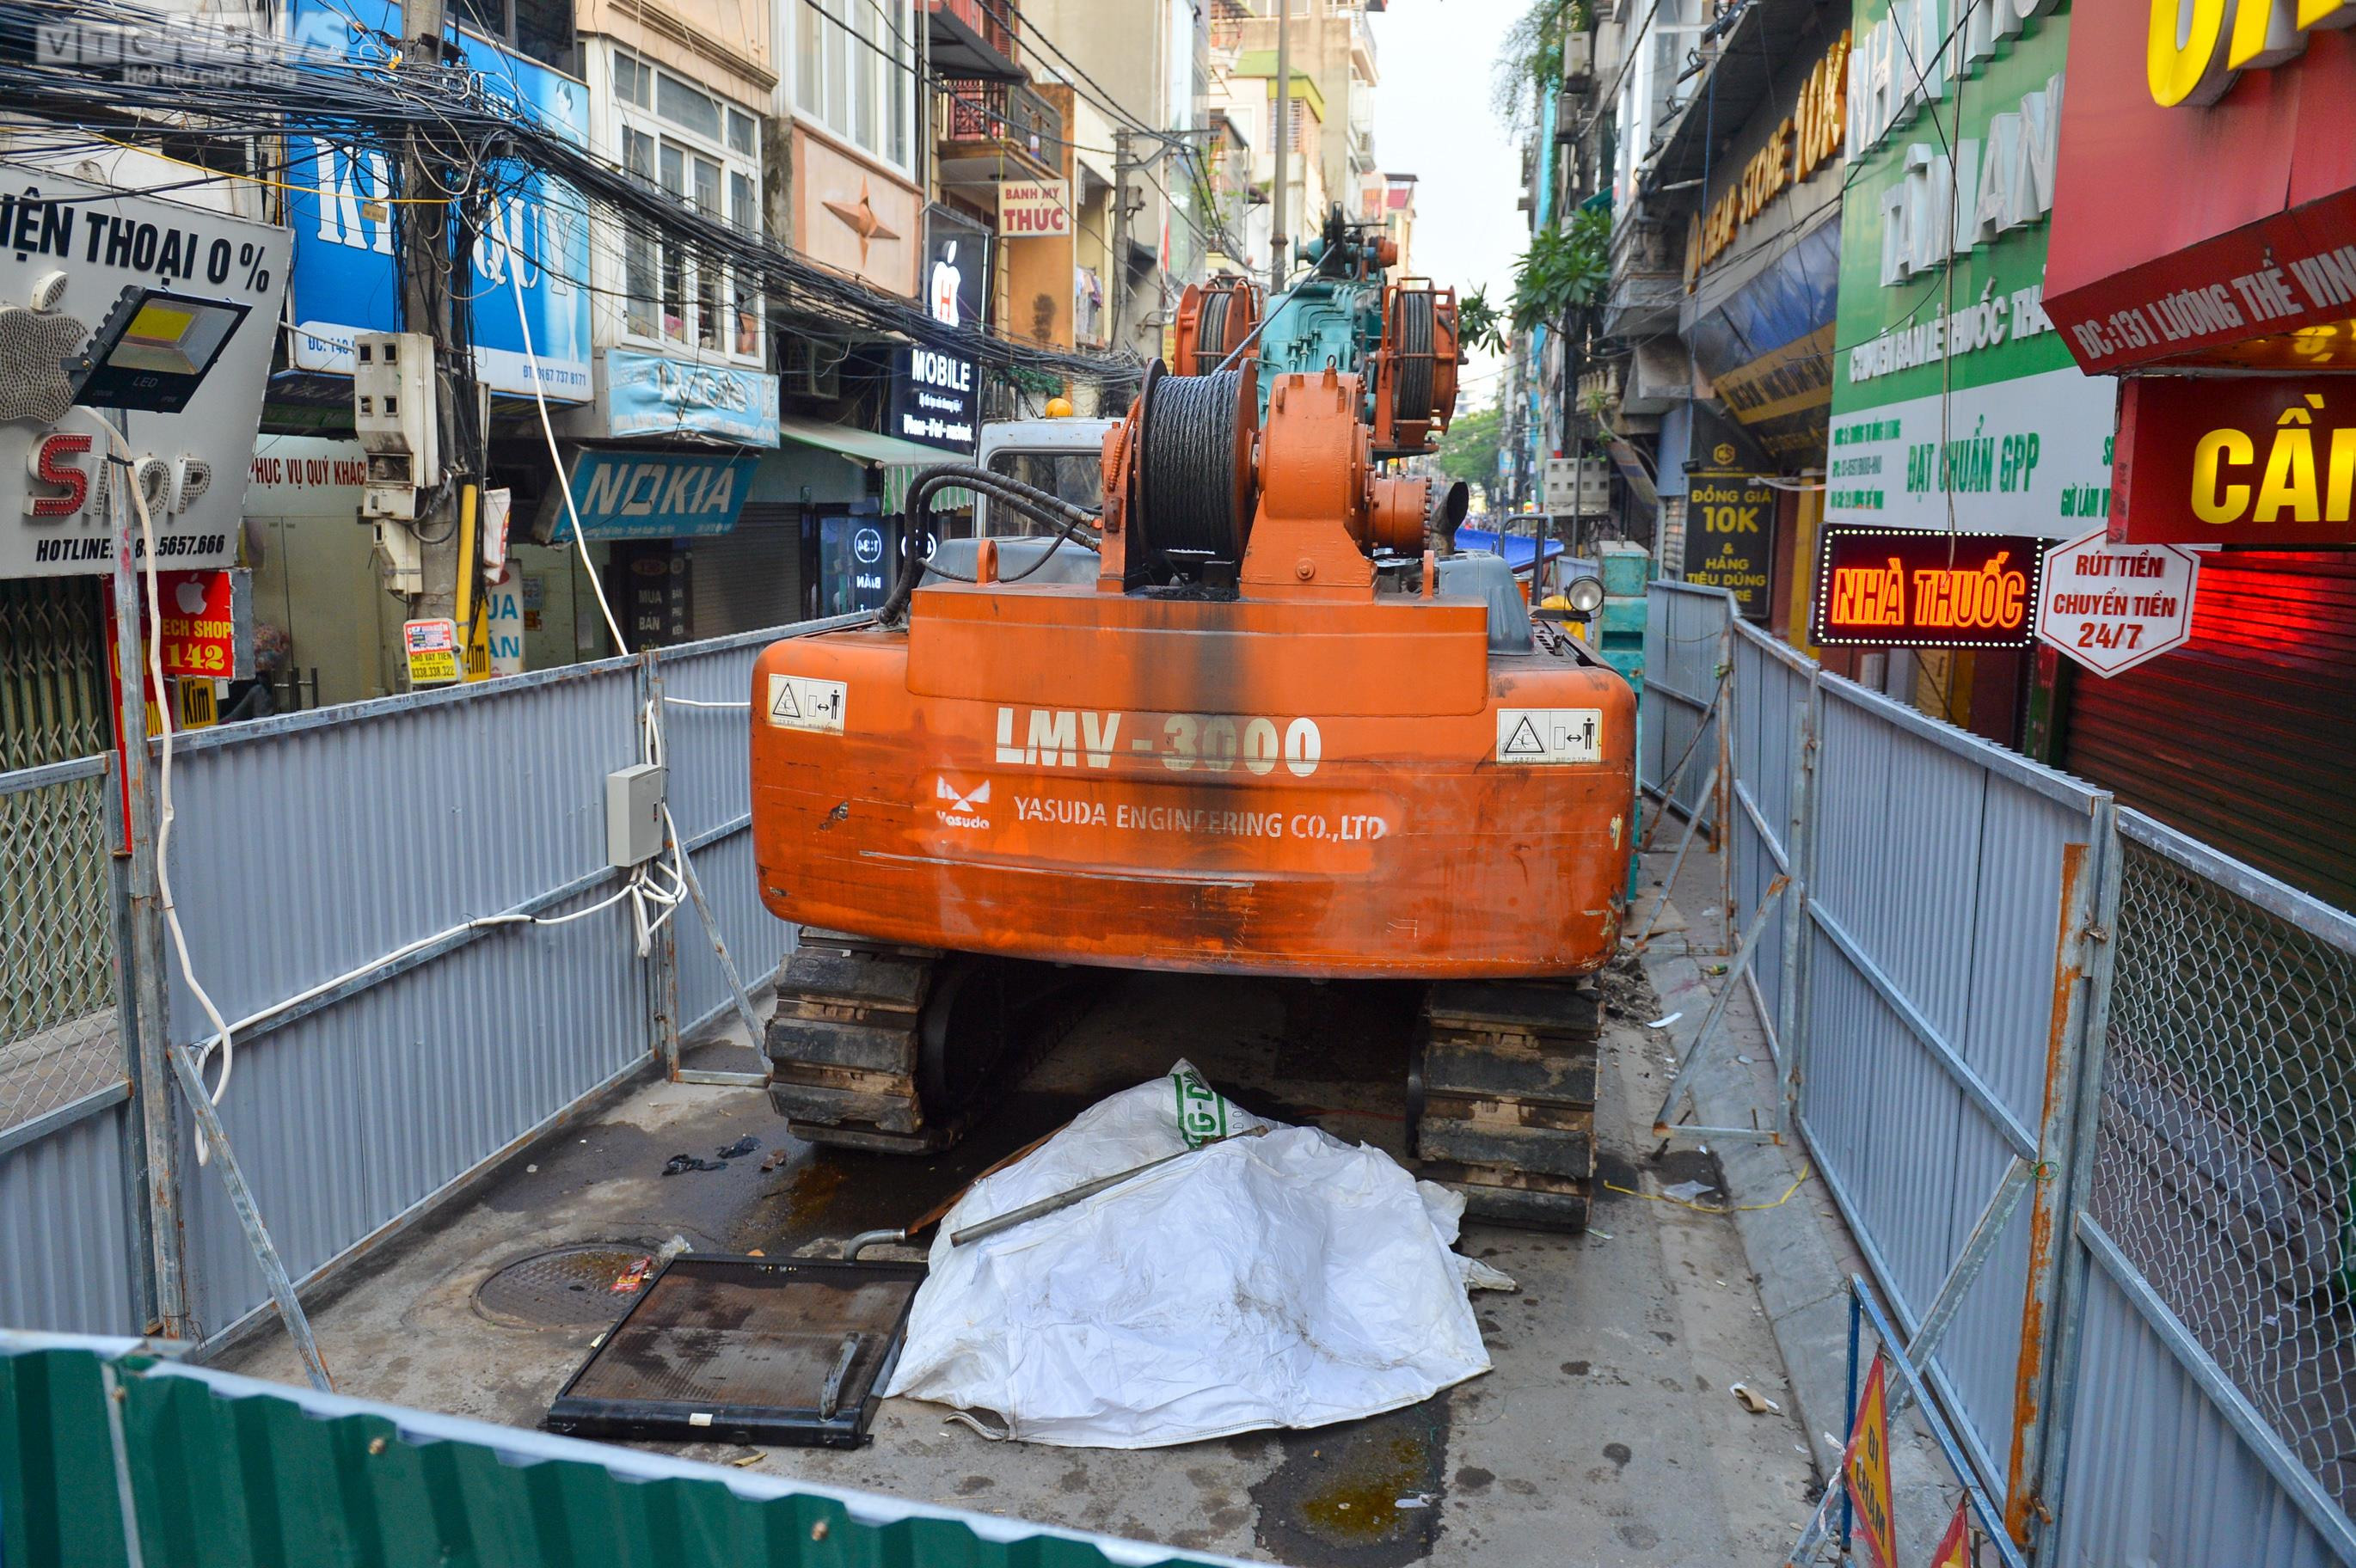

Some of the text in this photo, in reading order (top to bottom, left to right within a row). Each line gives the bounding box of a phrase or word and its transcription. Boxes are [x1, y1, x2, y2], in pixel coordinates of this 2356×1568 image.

[1003, 202, 1064, 231] THỨC
[85, 211, 199, 285] THOẠI
[2146, 283, 2245, 341] LƯƠNG
[2230, 247, 2305, 322] THẾ
[1895, 315, 1927, 371] BÁN
[132, 376, 159, 388] LED
[911, 348, 971, 392] MOBILE
[285, 458, 303, 490] VỤ
[306, 455, 330, 487] QUÝ
[1999, 432, 2040, 493] GPP
[580, 463, 736, 516] NOKIA
[1702, 506, 1760, 533] 10K
[1722, 542, 1734, 554] &
[2075, 549, 2166, 579] RÚT TIỀN
[1831, 551, 2026, 628] NHÀ THUỐC
[2052, 587, 2177, 618] CHUYỂN TIỀN
[163, 619, 234, 640] ECH SHOP
[2077, 622, 2144, 650] 24/7
[165, 642, 225, 671] 142
[181, 678, 212, 726] Kim
[1013, 795, 1108, 827] YASUDA
[1116, 804, 1283, 839] ENGINEERING
